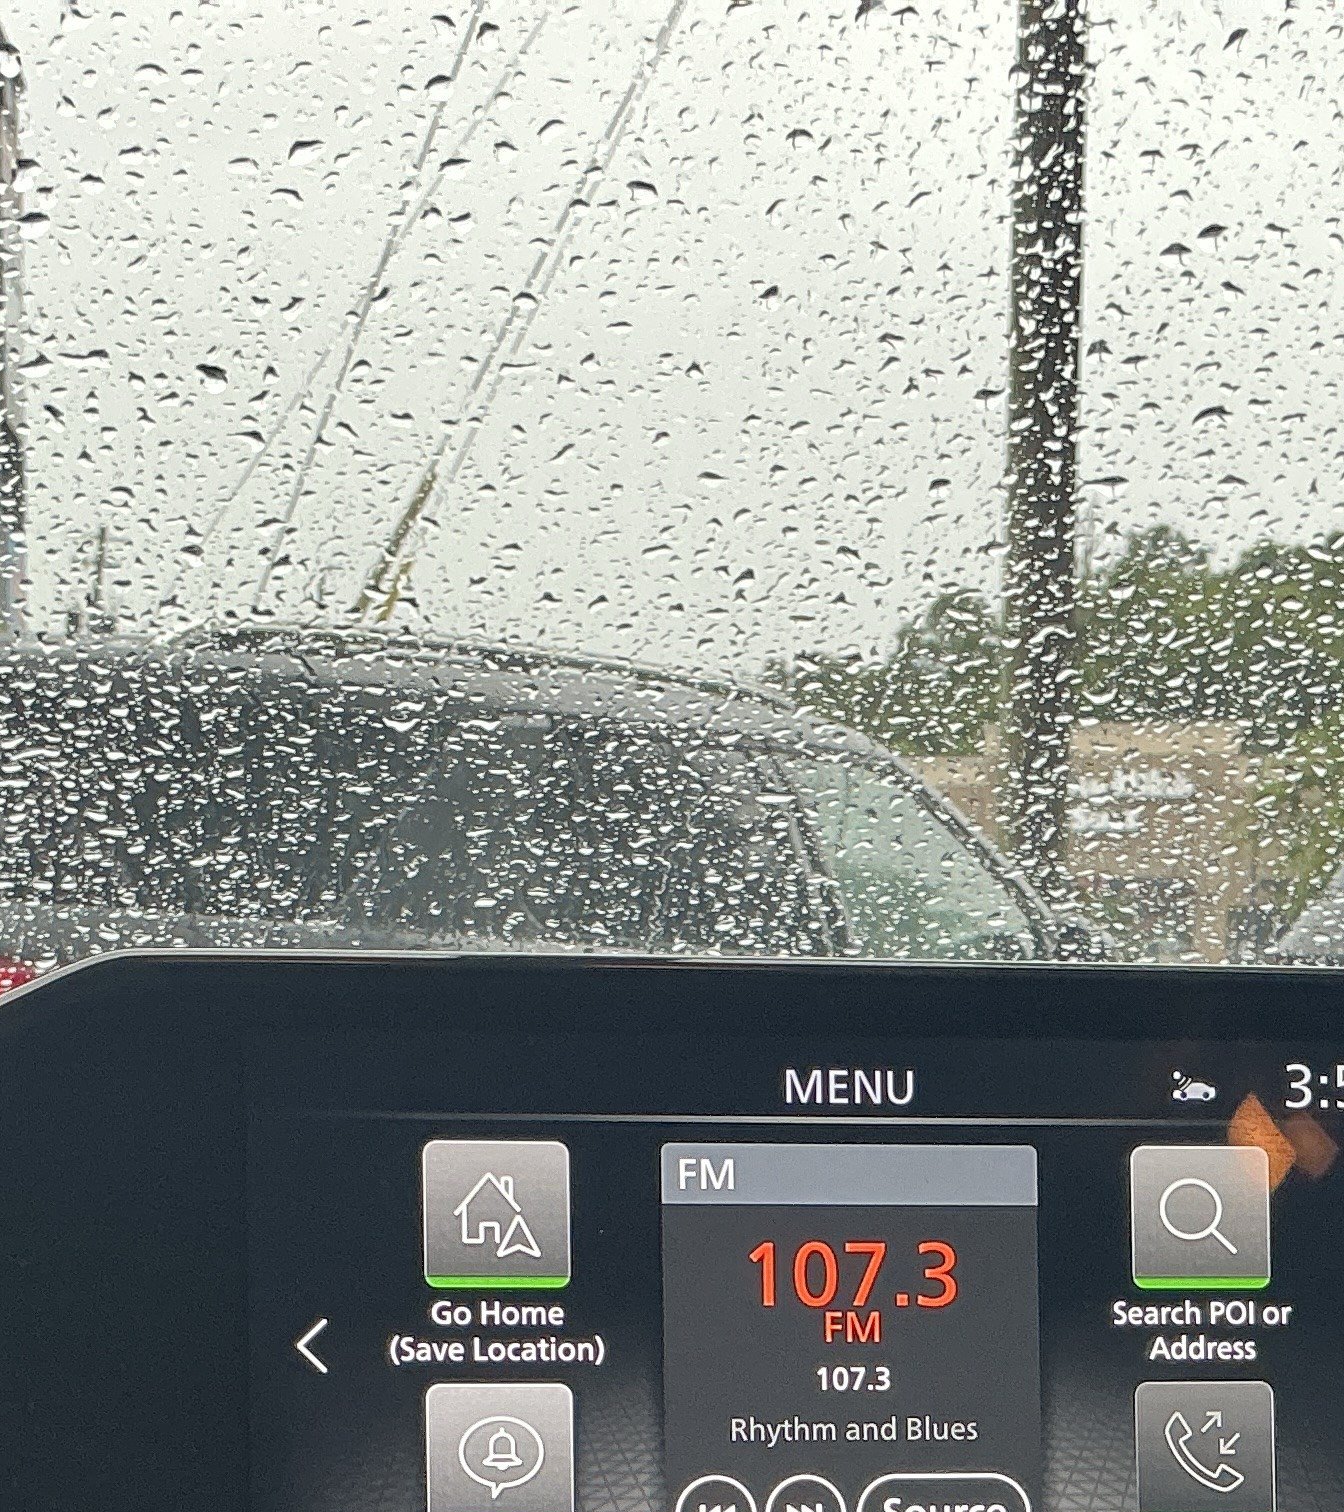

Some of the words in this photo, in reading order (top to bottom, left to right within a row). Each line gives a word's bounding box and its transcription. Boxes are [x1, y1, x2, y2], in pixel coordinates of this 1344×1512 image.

[785, 1068, 914, 1105] MENU
[679, 1157, 735, 1190] FM
[749, 1241, 957, 1307] 107.3
[431, 1299, 472, 1326] Go
[480, 1300, 565, 1327] Home
[824, 1311, 880, 1343] FM
[1113, 1299, 1202, 1326] Search
[1209, 1300, 1255, 1325] POI
[1262, 1305, 1293, 1326] or
[389, 1334, 465, 1366] (Save
[473, 1335, 605, 1366] Location)
[1149, 1334, 1257, 1361] Address
[816, 1366, 891, 1391] 107.3
[731, 1415, 837, 1448] Rhythm
[845, 1415, 897, 1441] and
[906, 1415, 979, 1441] Blues
